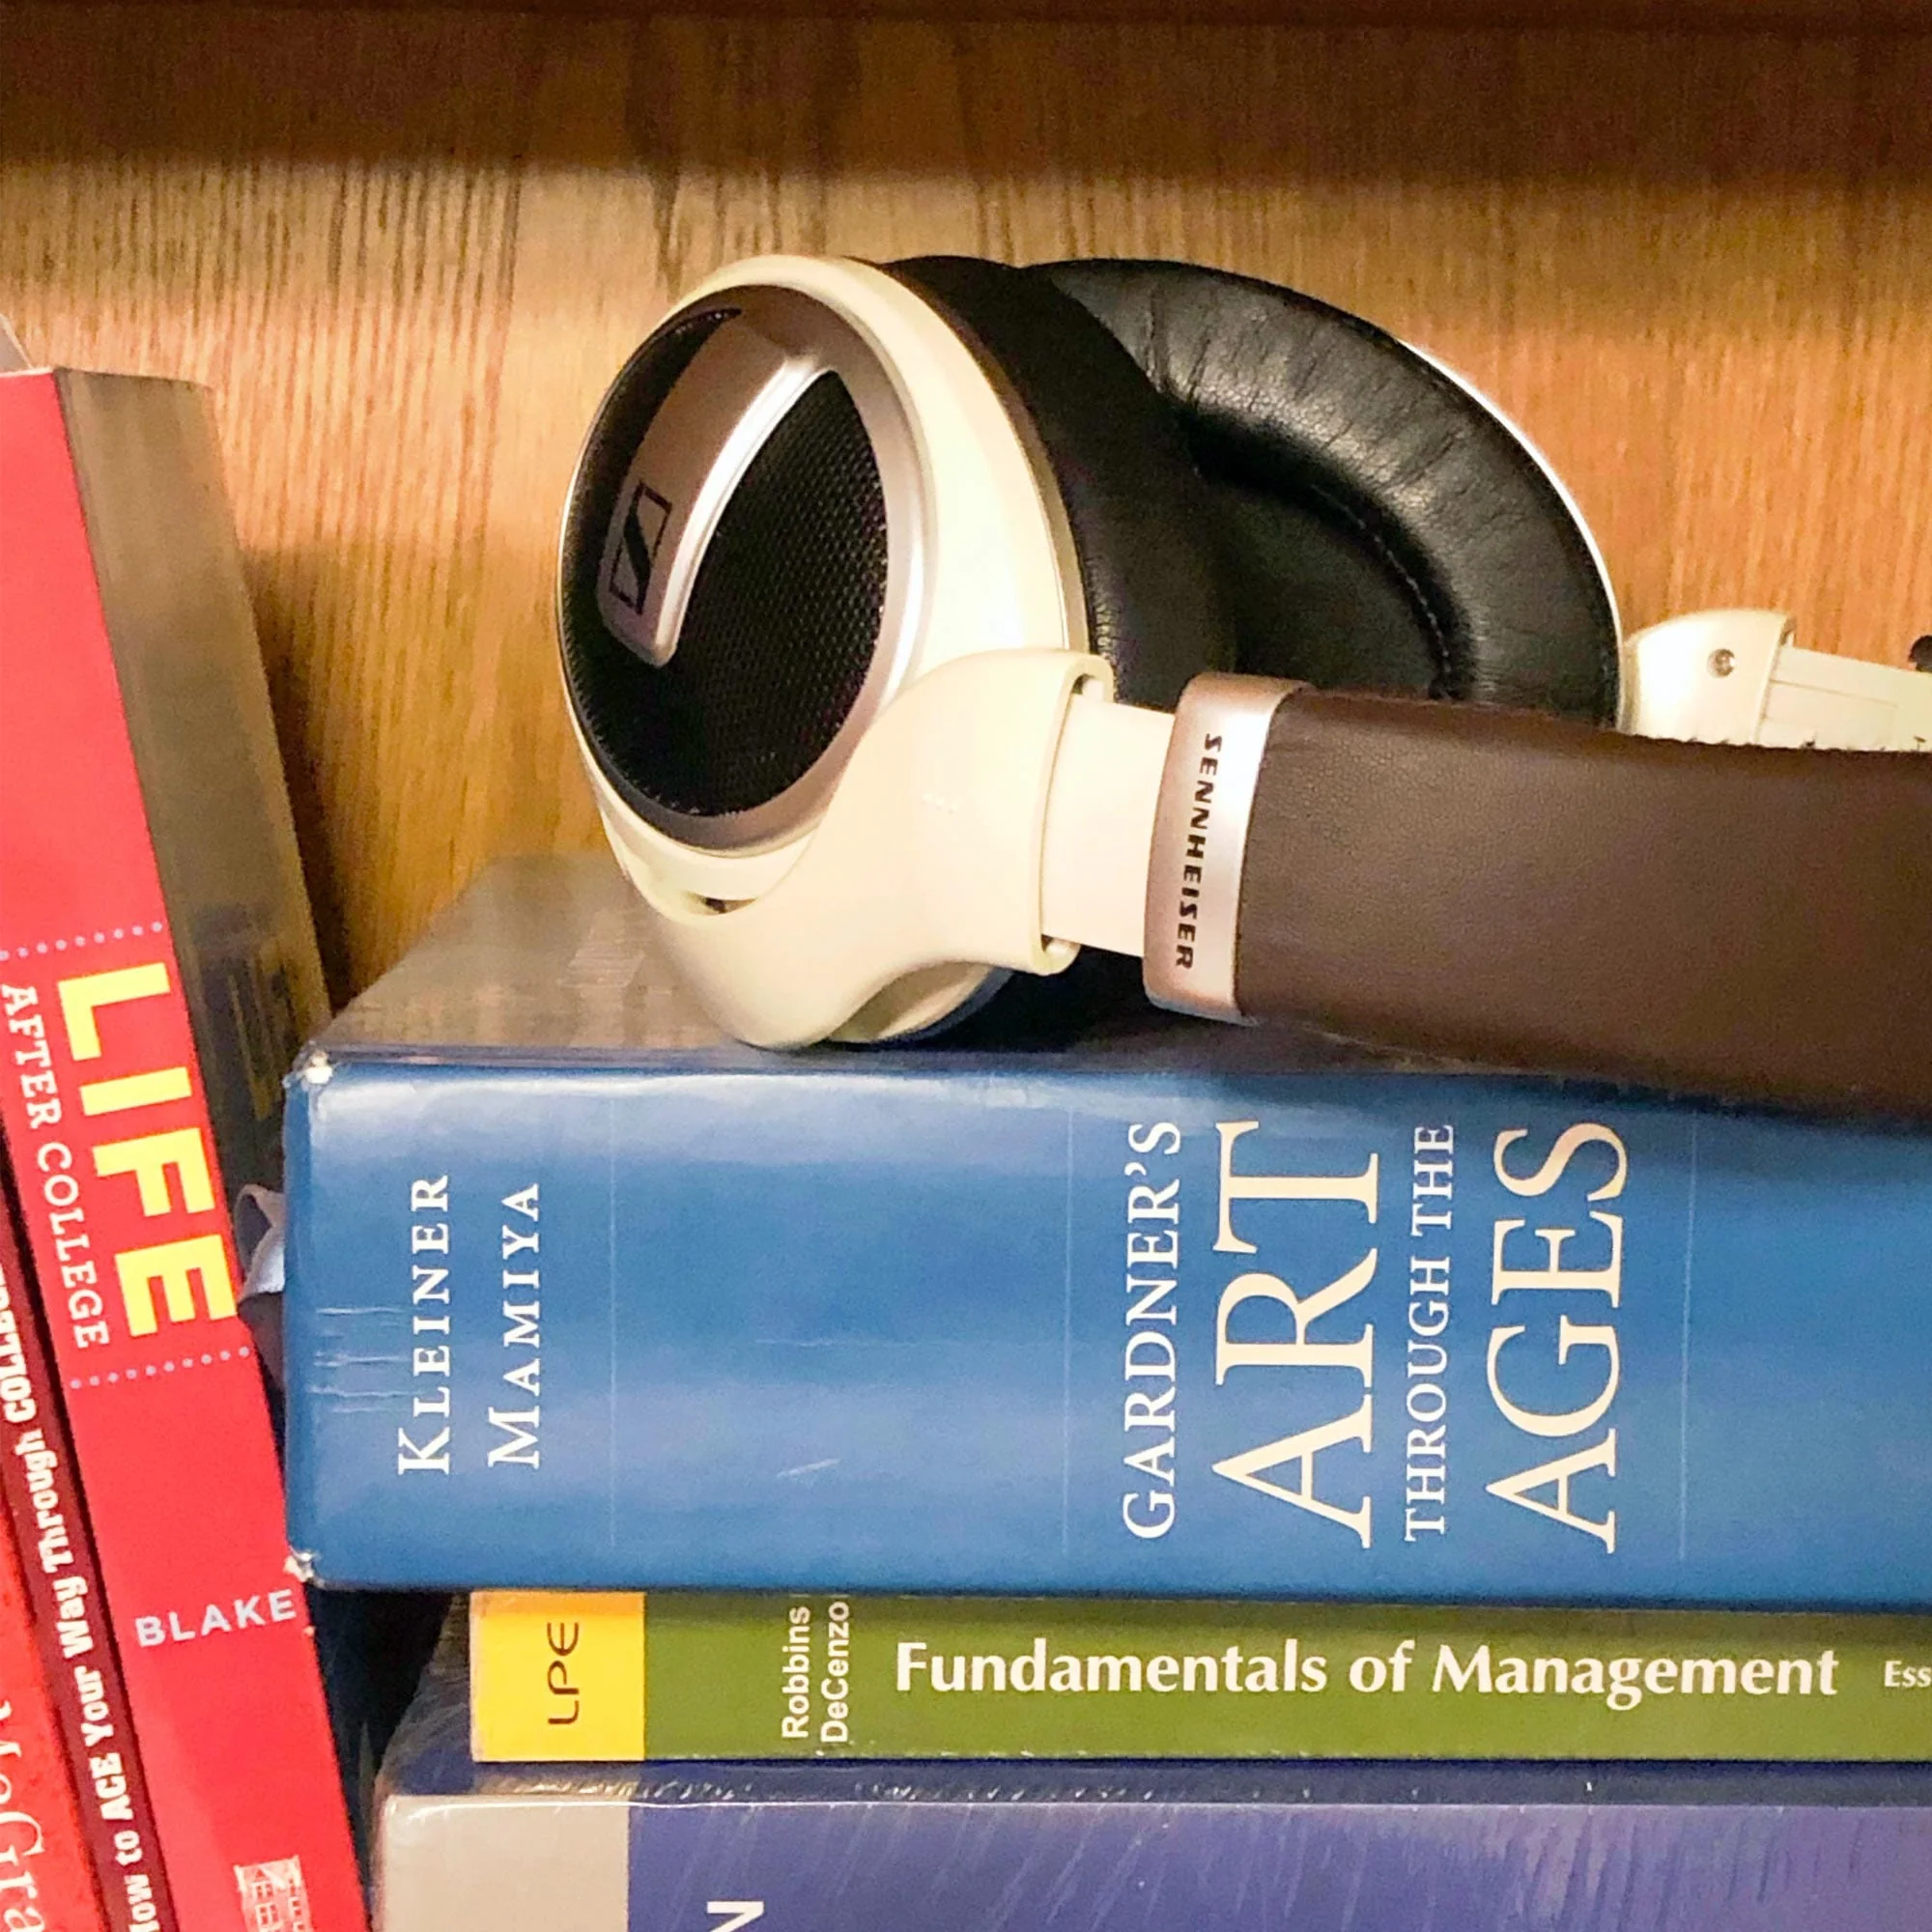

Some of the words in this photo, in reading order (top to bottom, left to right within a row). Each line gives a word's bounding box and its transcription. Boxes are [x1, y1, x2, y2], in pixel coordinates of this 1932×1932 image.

[1175, 733, 1222, 970] SENNHEISER
[2, 982, 63, 1128] AFTER
[37, 1142, 110, 1349] COLLEGE
[58, 962, 238, 1337] LIFE
[1410, 1123, 1454, 1236] THE
[397, 1175, 450, 1475] KLEINER
[487, 1183, 540, 1469] MAMIYA
[1211, 1120, 1378, 1548] ART
[1486, 1122, 1629, 1554] AGES
[1405, 1256, 1451, 1542] THROUGH
[14, 1428, 74, 1573] Through
[53, 1576, 94, 1659] Way
[134, 1589, 297, 1648] BLAKE
[547, 1622, 580, 1725] LPE
[781, 1605, 811, 1739] Robbins
[820, 1601, 851, 1743] DeCenzo
[895, 1637, 1327, 1692] Fundamentals
[1349, 1638, 1416, 1692] of
[1432, 1643, 1839, 1711] Management
[74, 1666, 114, 1747] Your
[89, 1751, 134, 1821] ACE
[114, 1830, 143, 1866] to
